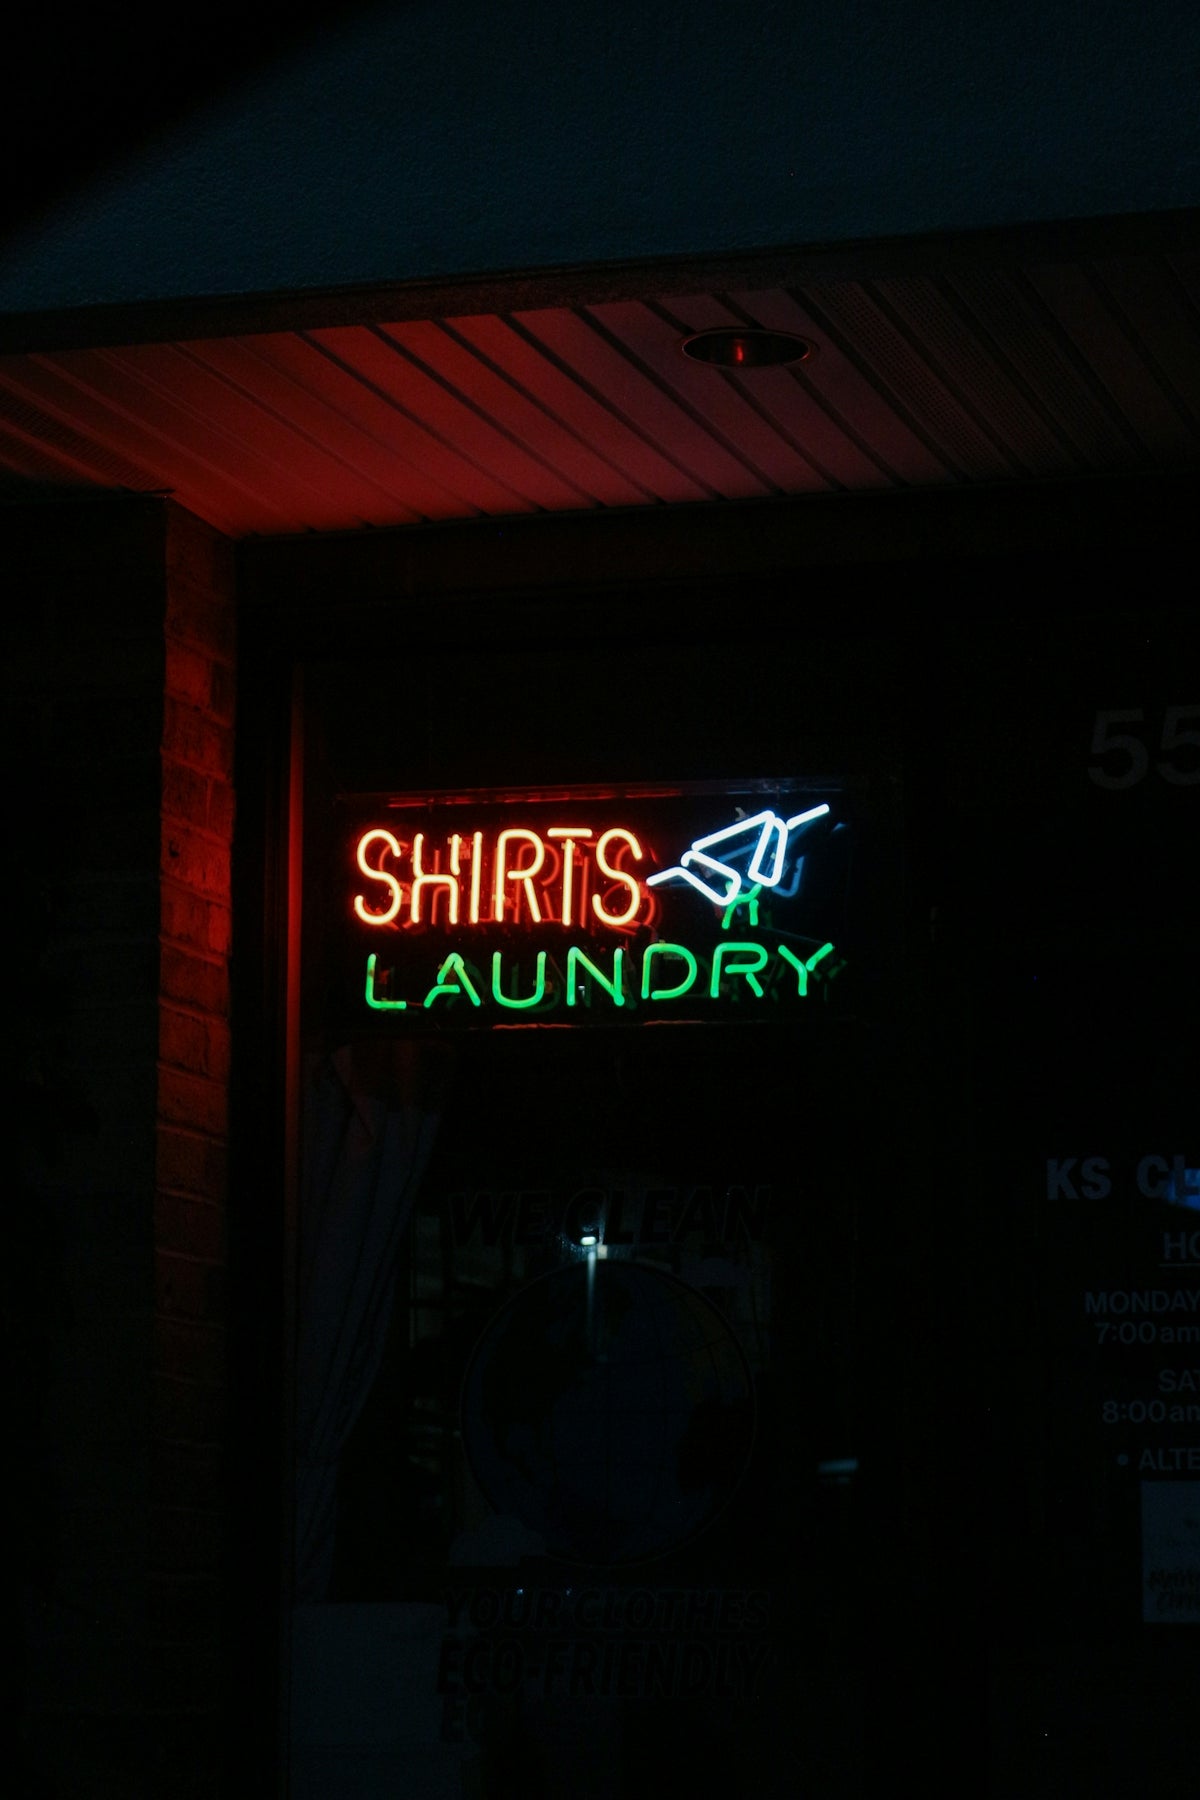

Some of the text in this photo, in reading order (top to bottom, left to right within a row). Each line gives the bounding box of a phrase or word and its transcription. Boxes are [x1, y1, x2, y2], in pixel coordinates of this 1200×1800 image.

[1088, 704, 1200, 791] 55
[353, 828, 643, 927] SHIRTS
[365, 942, 834, 1010] LAUNDRY
[1046, 1155, 1113, 1201] KS
[447, 1184, 773, 1249] WE CLEAN
[1083, 1289, 1200, 1314] MONDAY
[1094, 1320, 1200, 1345] 7:00am
[438, 1585, 774, 1633] YOUR CLOTHES
[435, 1637, 775, 1700] ECO-FRIENDLY
